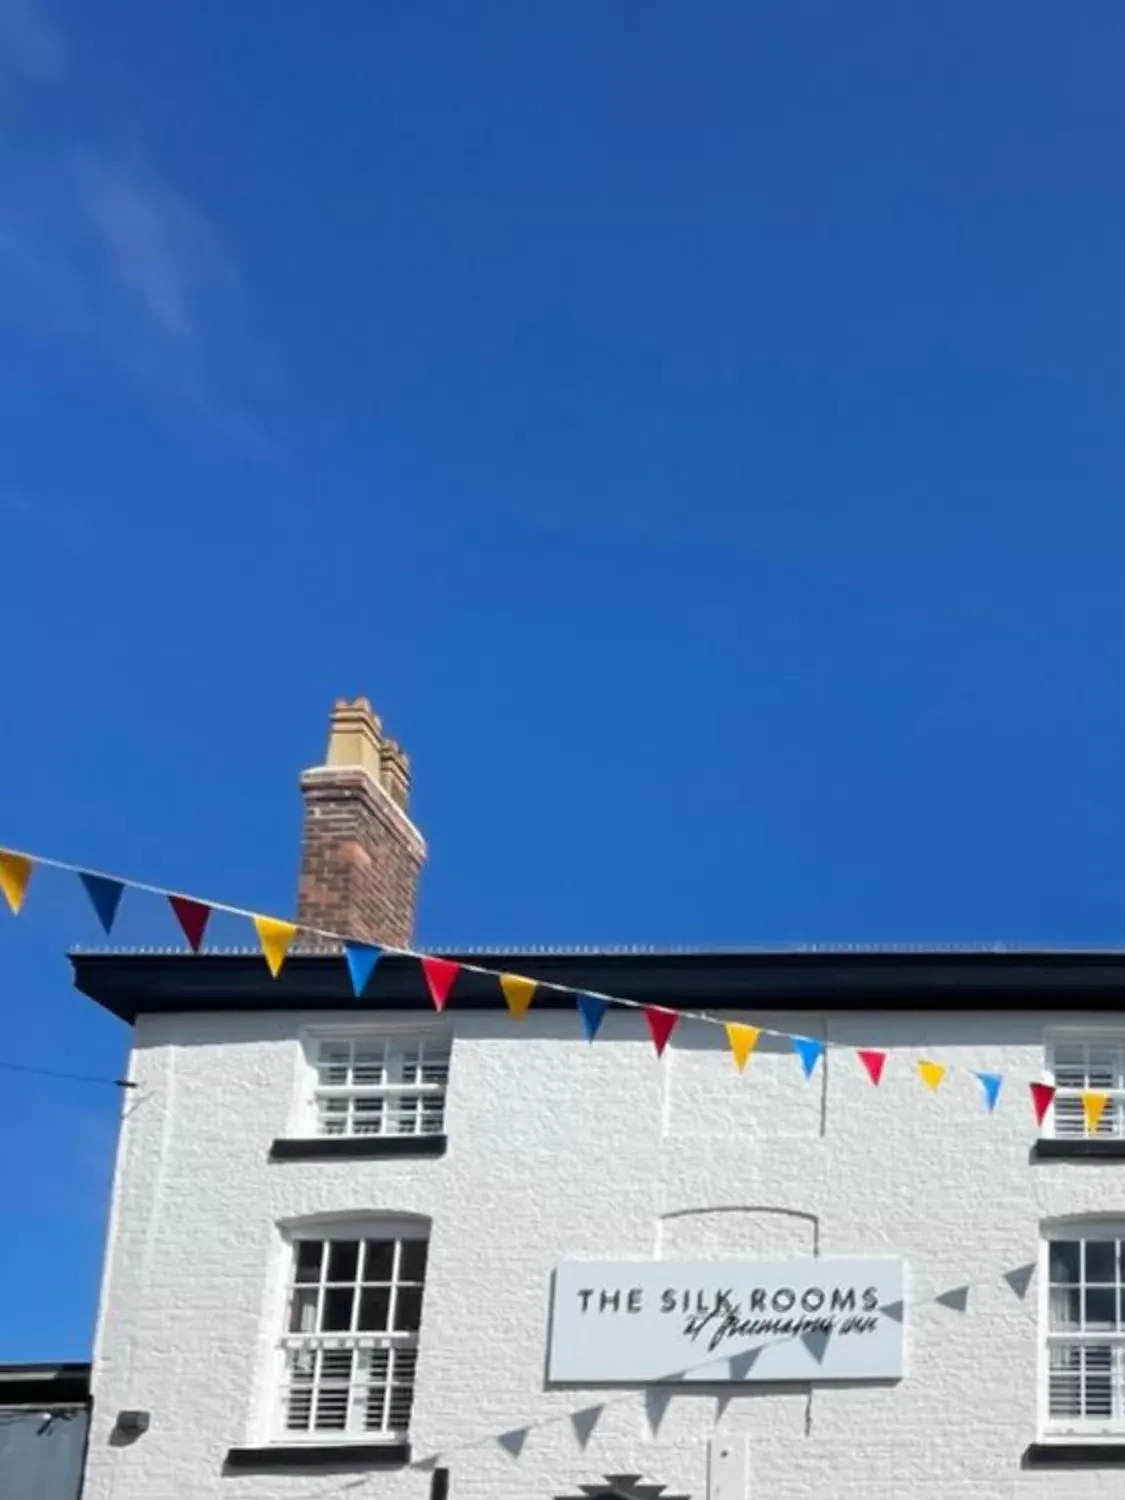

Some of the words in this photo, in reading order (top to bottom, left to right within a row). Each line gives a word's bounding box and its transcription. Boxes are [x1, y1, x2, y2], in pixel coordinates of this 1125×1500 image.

[577, 1288, 643, 1313] THE
[660, 1287, 733, 1314] SILK
[750, 1287, 879, 1313] ROOMS
